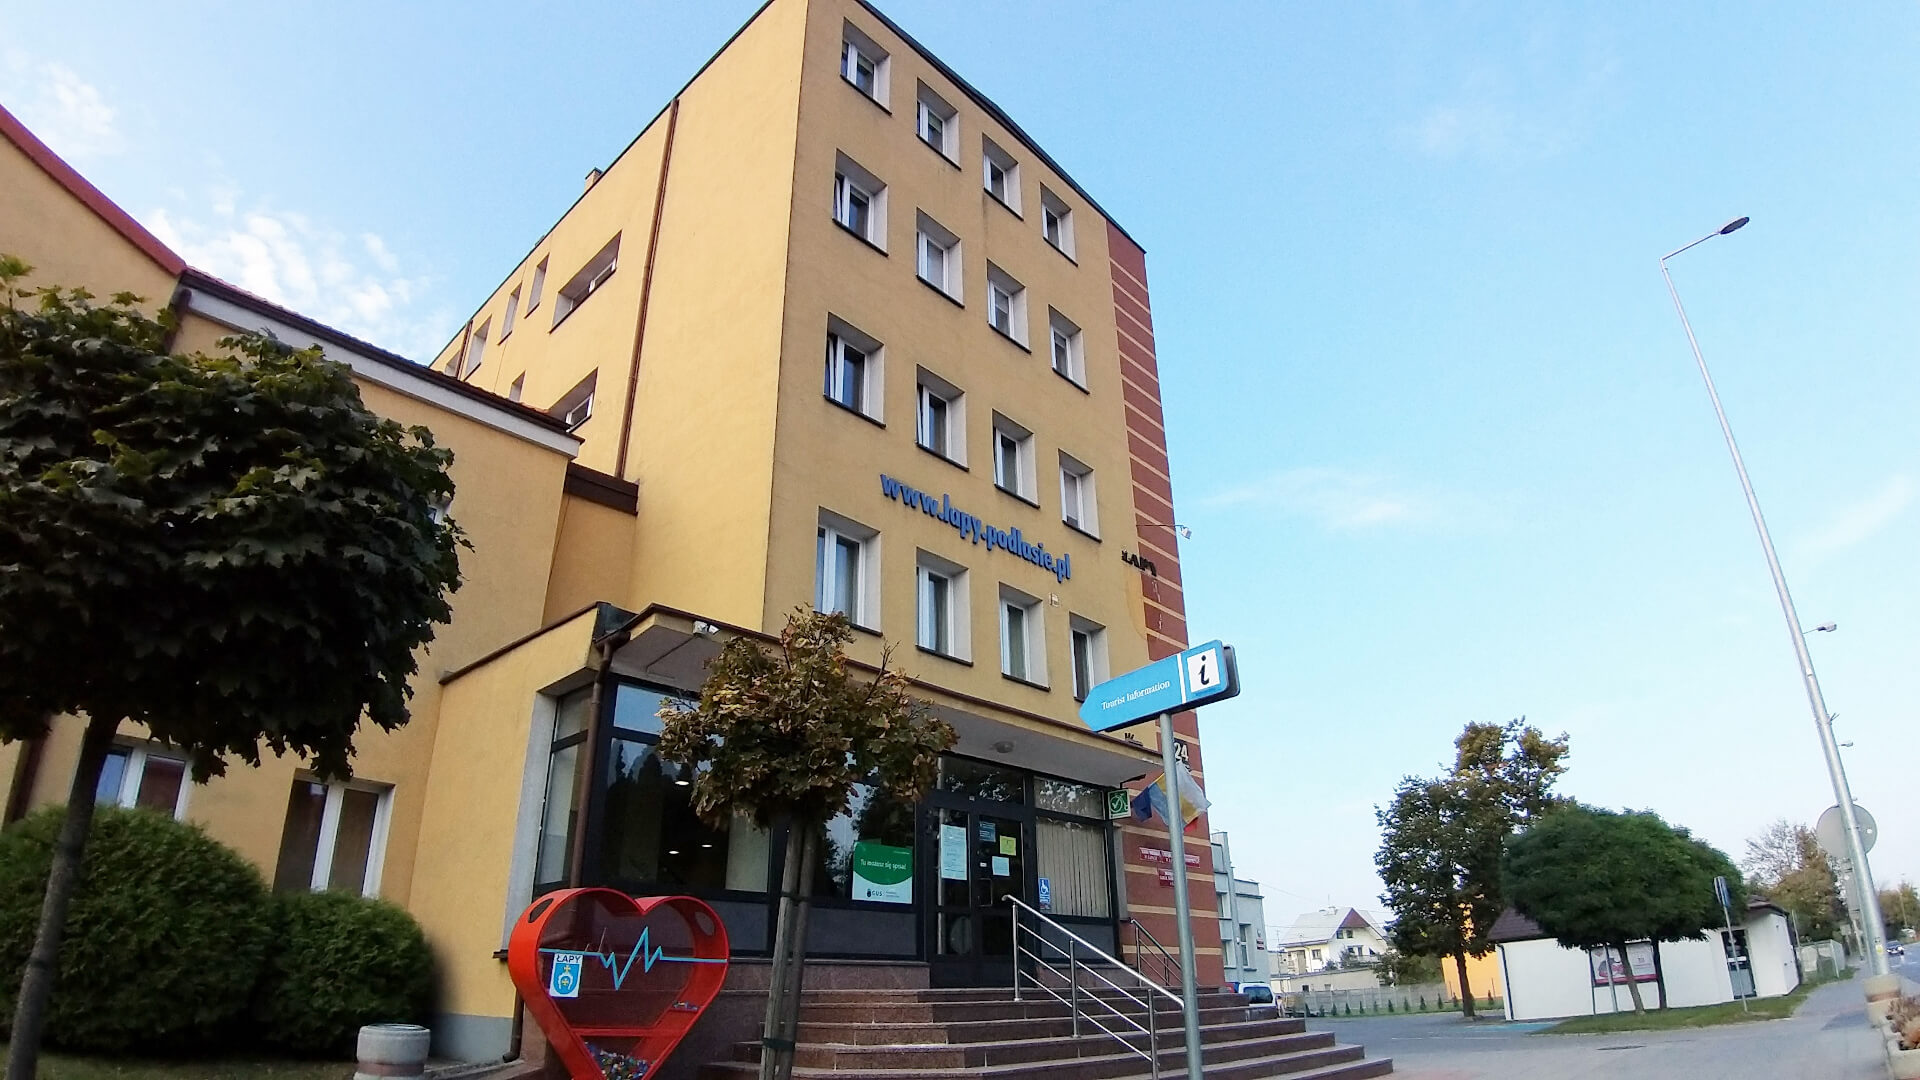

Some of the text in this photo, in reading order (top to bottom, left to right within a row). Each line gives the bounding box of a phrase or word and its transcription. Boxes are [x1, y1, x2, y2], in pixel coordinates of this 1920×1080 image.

[880, 474, 1072, 583] www.lapy.podlasie.pl
[1101, 680, 1171, 711] Tourist Information
[1174, 743, 1189, 762] 24
[556, 954, 581, 964] ŁAPY
